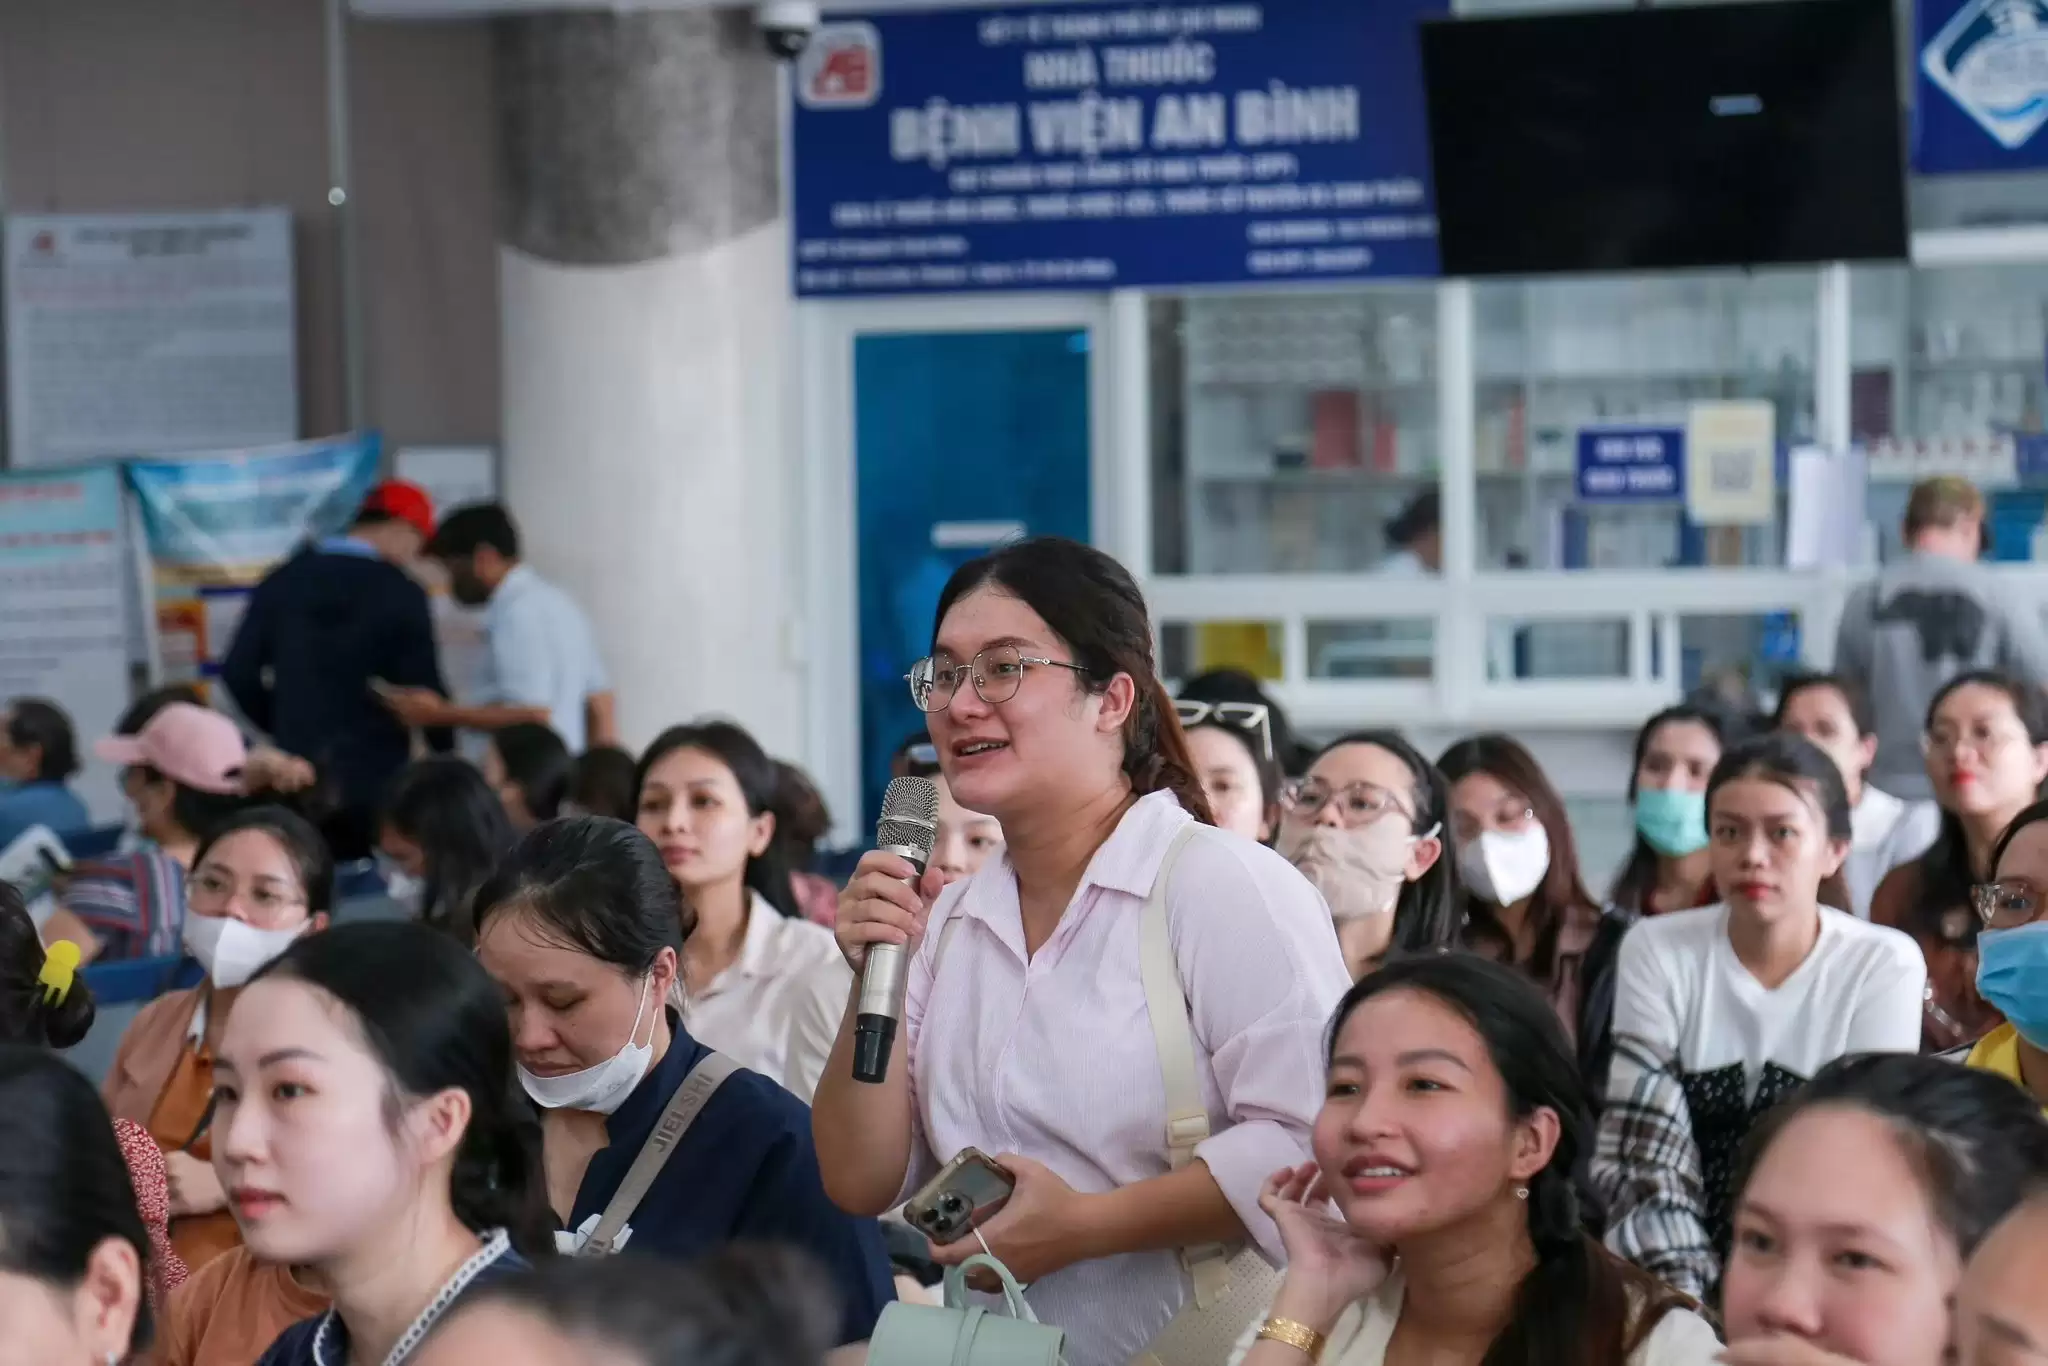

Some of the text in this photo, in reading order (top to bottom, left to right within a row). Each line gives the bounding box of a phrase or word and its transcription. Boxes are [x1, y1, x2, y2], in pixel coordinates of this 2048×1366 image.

[891, 80, 1359, 169] BỆNH VIỆN AN BÌNH
